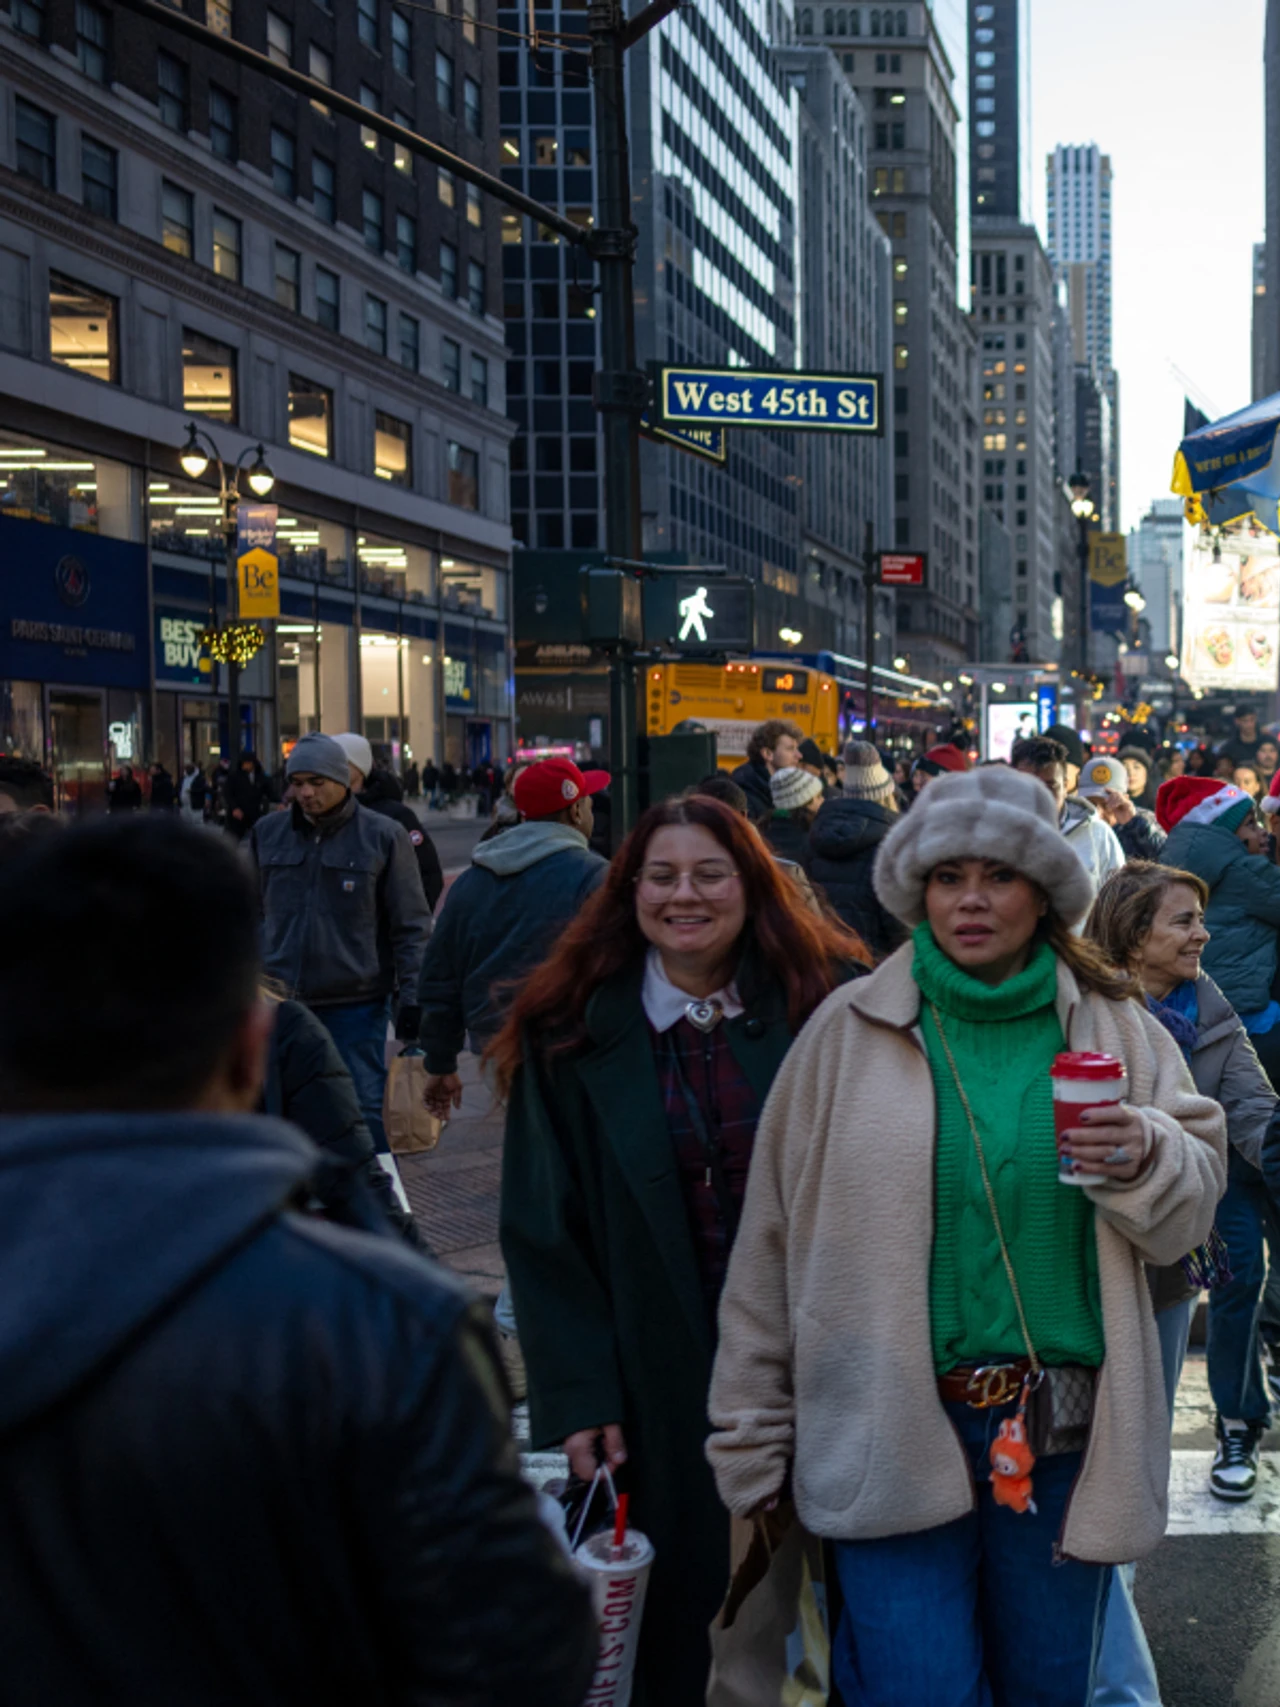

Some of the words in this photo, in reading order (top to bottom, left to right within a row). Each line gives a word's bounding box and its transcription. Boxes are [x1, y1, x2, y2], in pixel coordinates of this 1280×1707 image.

[673, 381, 753, 414] West
[760, 386, 829, 418] 45th
[836, 389, 870, 420] St
[244, 564, 274, 590] Be
[11, 618, 49, 641] PARIS
[160, 617, 205, 642] BEST
[164, 642, 202, 668] BUY
